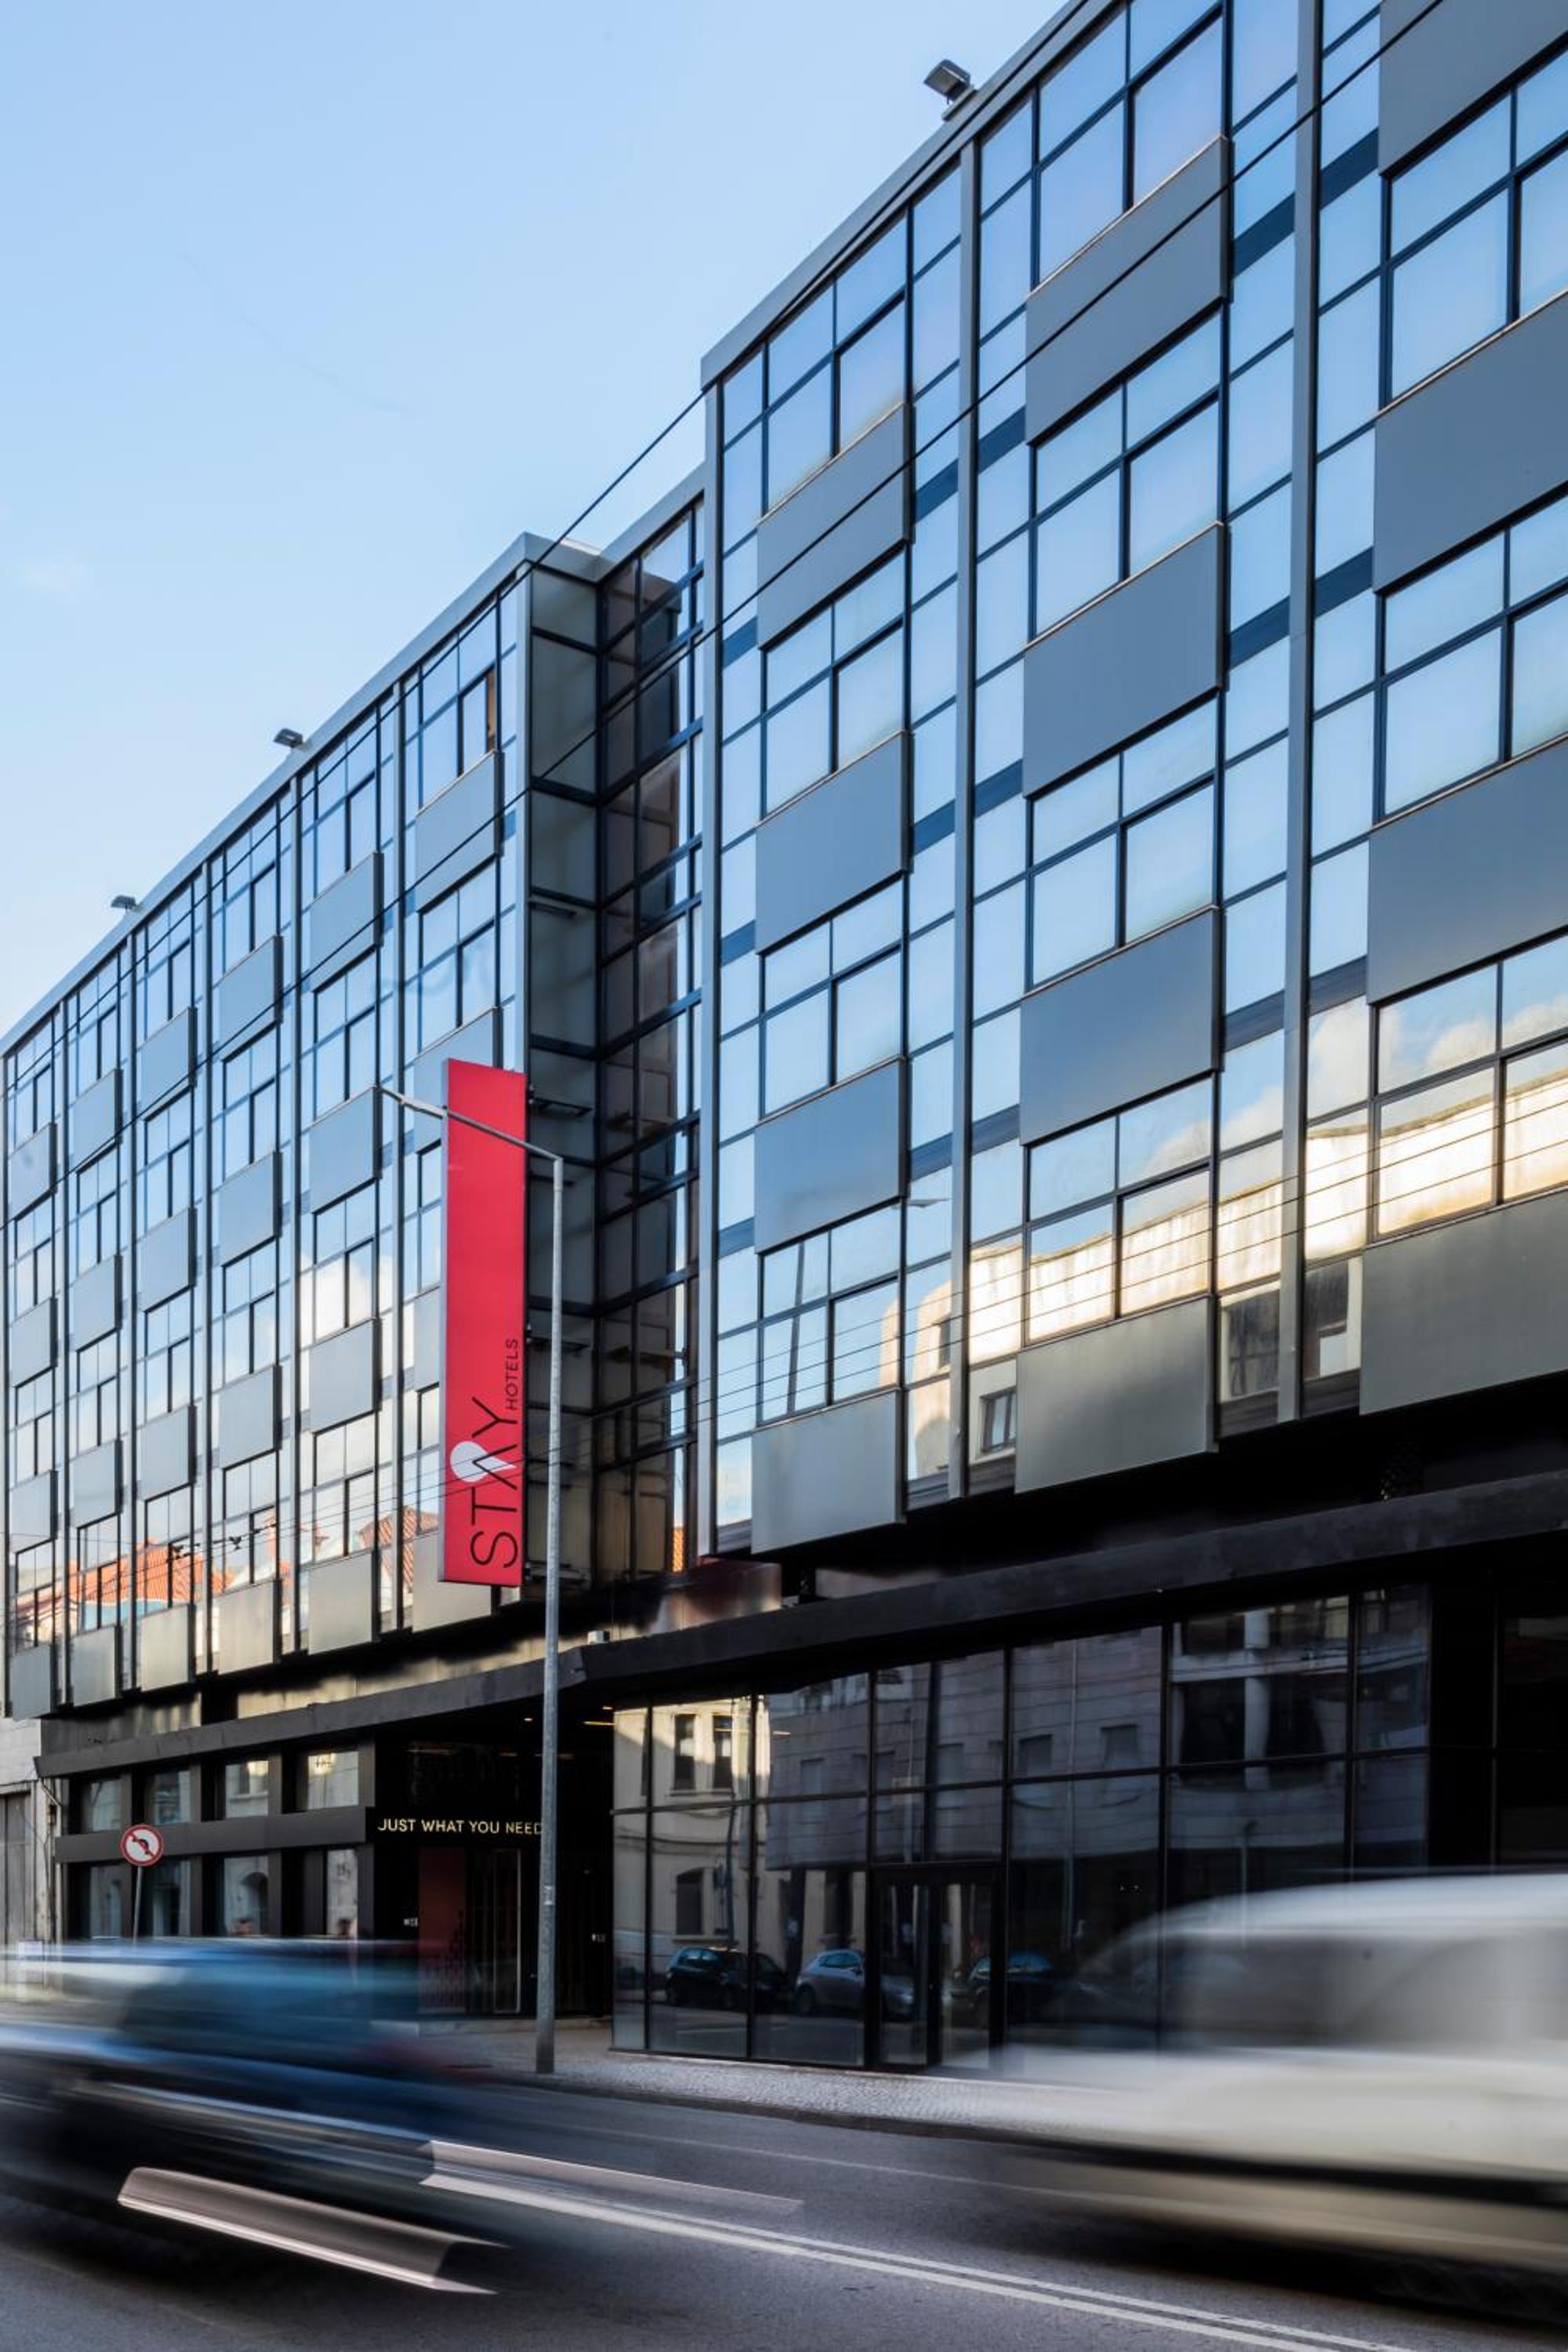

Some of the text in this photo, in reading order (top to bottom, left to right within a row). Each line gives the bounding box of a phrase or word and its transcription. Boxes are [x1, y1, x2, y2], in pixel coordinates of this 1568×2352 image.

[470, 1338, 519, 1568] STAY HOTELS
[377, 1818, 416, 1832] JUST
[421, 1819, 465, 1833] WHAT
[469, 1820, 500, 1834] YOU
